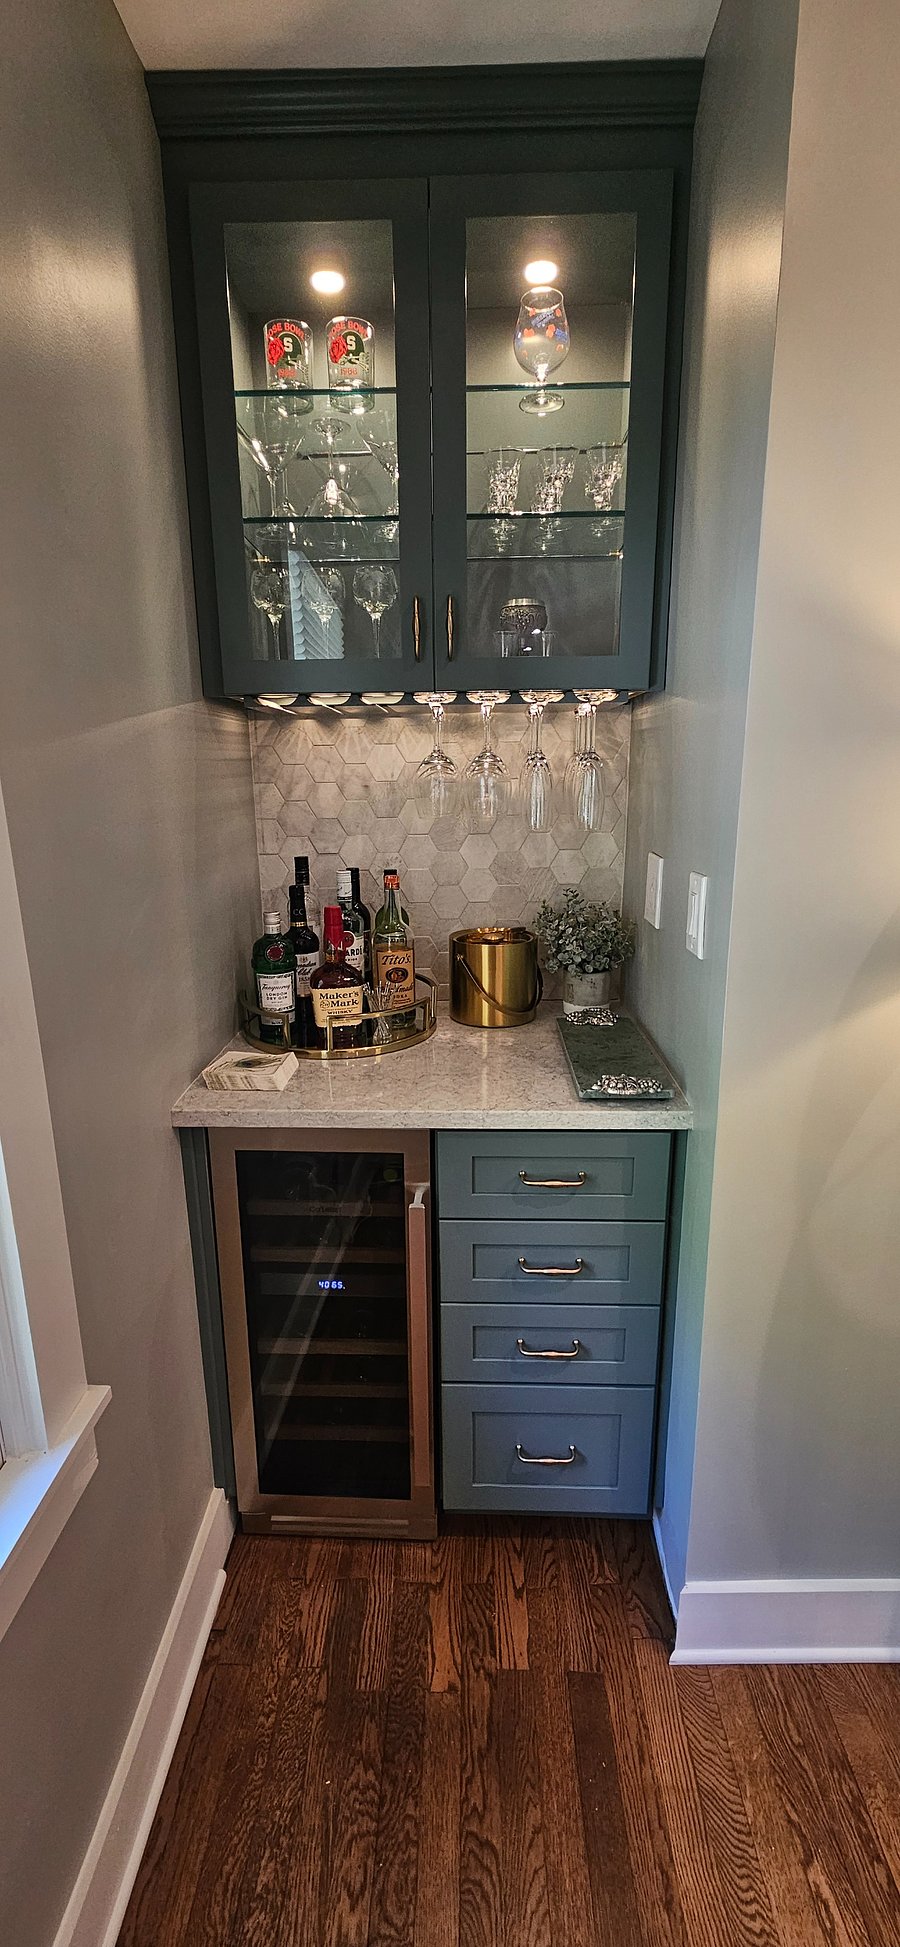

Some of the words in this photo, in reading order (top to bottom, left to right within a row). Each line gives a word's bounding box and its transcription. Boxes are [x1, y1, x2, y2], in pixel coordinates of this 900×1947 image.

[283, 337, 293, 352] S
[346, 335, 356, 351] S
[381, 953, 411, 966] Tito's
[320, 991, 360, 1000] Maker's
[330, 999, 360, 1008] Mark
